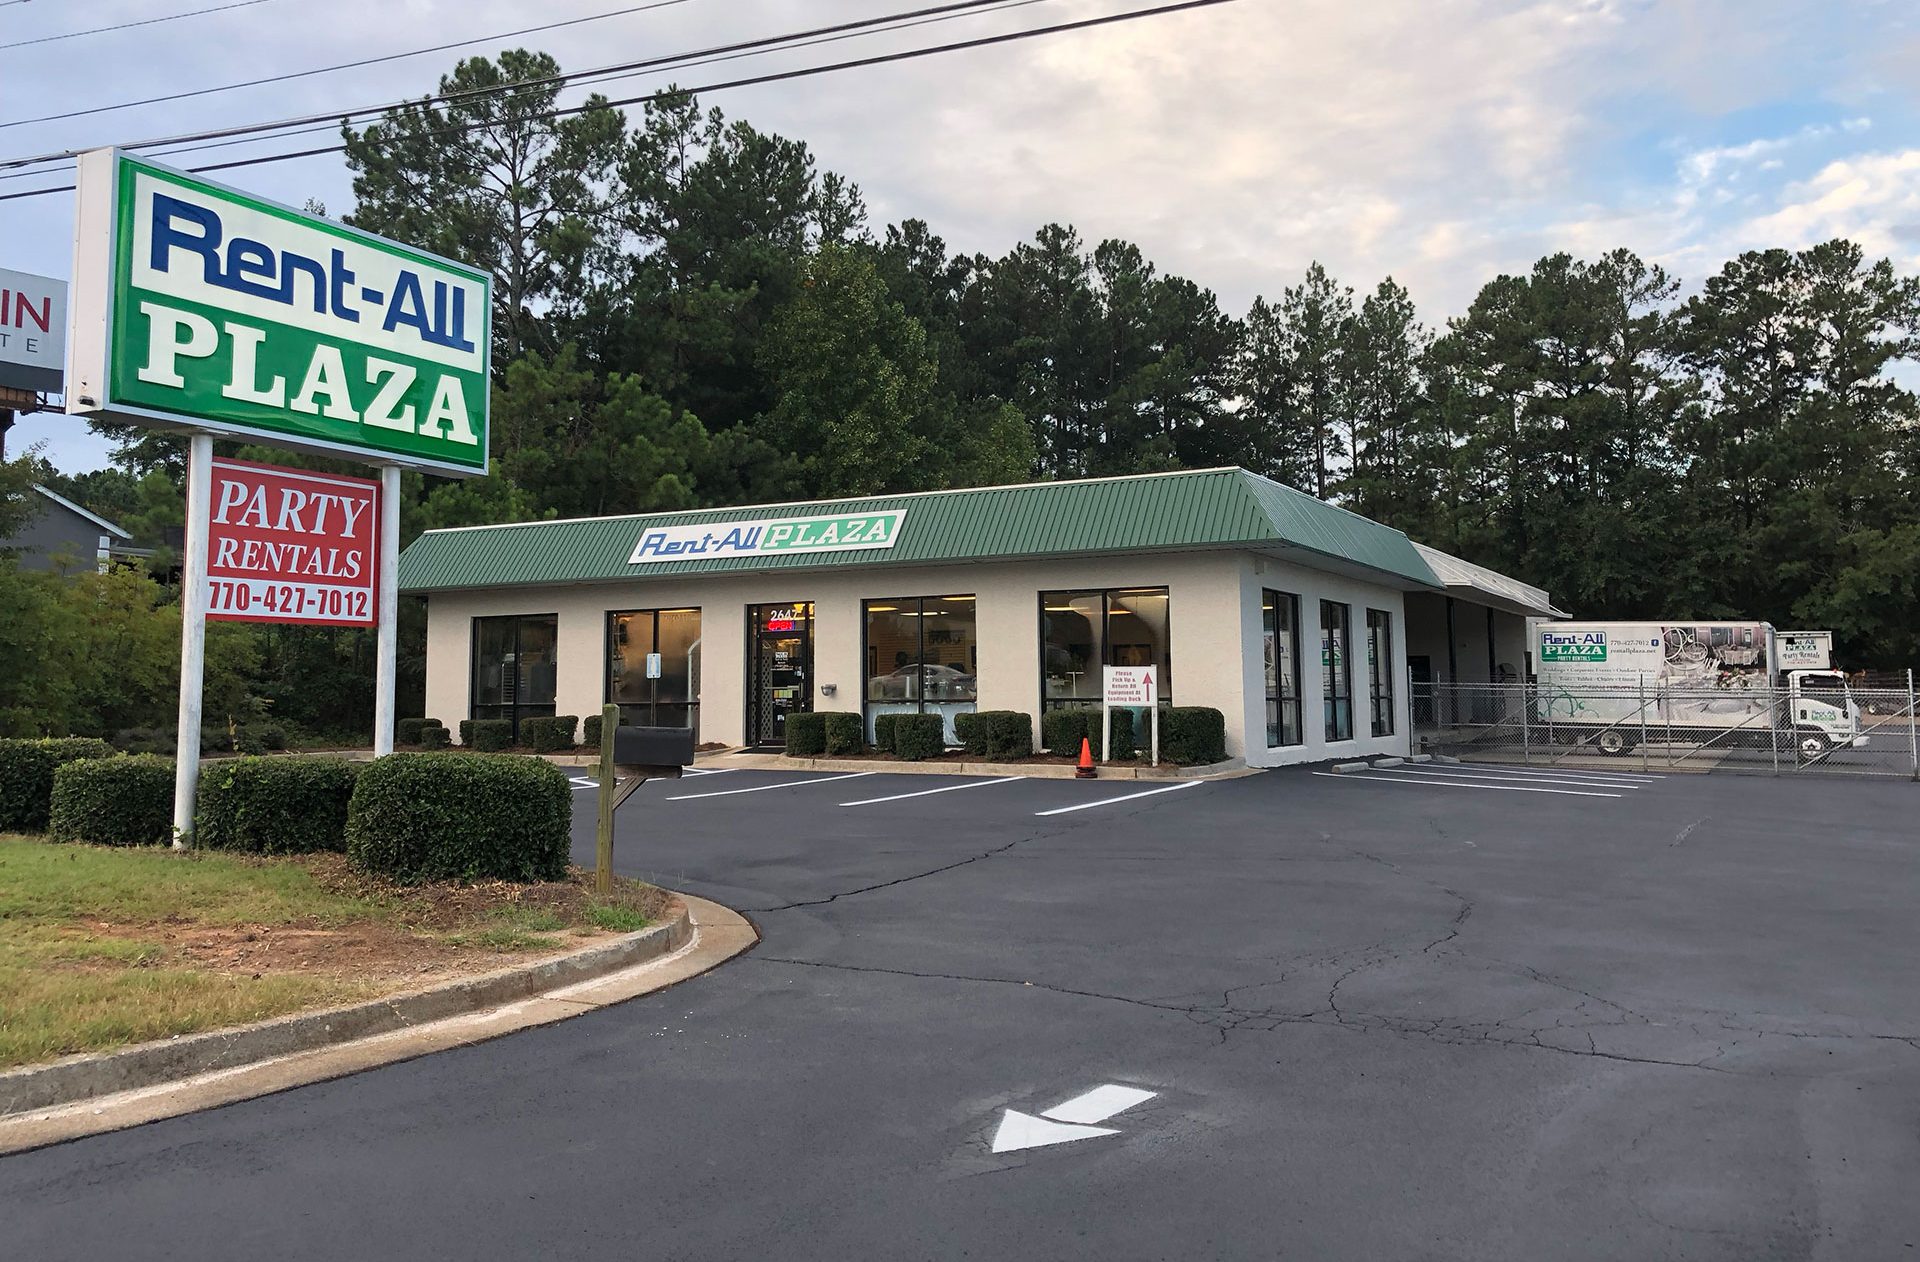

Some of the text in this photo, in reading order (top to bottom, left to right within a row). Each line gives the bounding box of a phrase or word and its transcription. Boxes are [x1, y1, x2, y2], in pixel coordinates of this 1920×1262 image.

[150, 192, 475, 353] Rent-All
[138, 301, 478, 446] PLAZA
[212, 480, 370, 538] PARTY
[638, 518, 888, 556] Rent-All PLAZA
[213, 537, 362, 579] RENTALS
[209, 581, 367, 617] 770-427-7012
[770, 609, 798, 621] 2647
[1543, 633, 1605, 645] Rent-All
[1545, 646, 1603, 655] PLAZA
